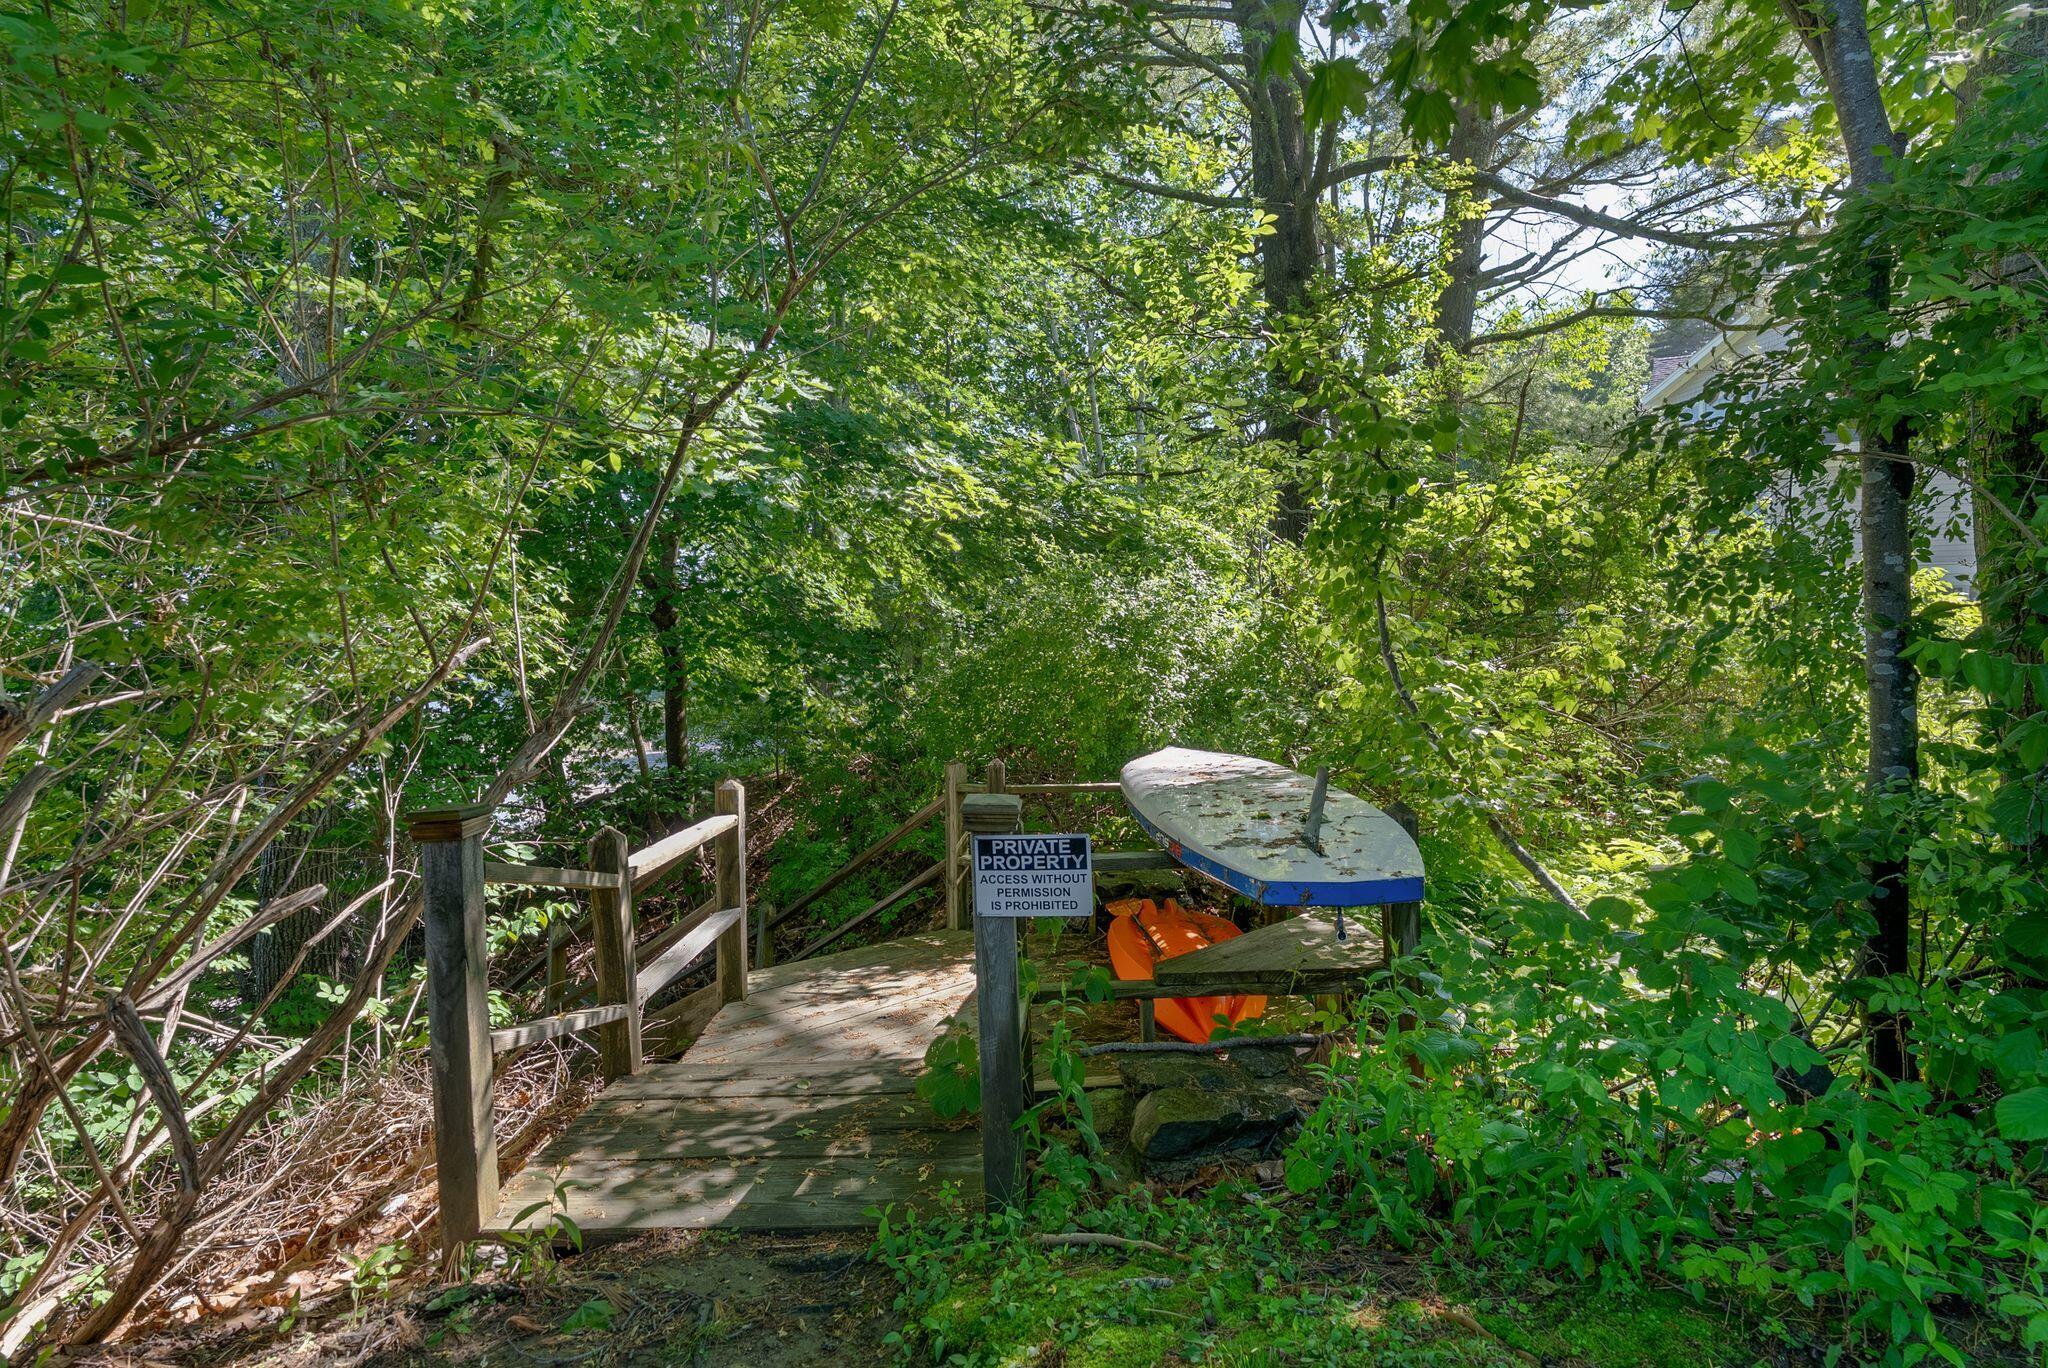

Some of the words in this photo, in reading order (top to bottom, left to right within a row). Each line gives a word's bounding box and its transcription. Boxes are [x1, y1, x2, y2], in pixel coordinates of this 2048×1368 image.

[992, 839, 1071, 855] PRIVATE
[980, 854, 1085, 870] PROPERTY
[980, 874, 1029, 885] ACCESS
[1031, 873, 1087, 884] WITHOUT
[997, 887, 1071, 898] PERMISSION
[991, 901, 1002, 911] IS
[1005, 900, 1078, 911] PROHIBITED
